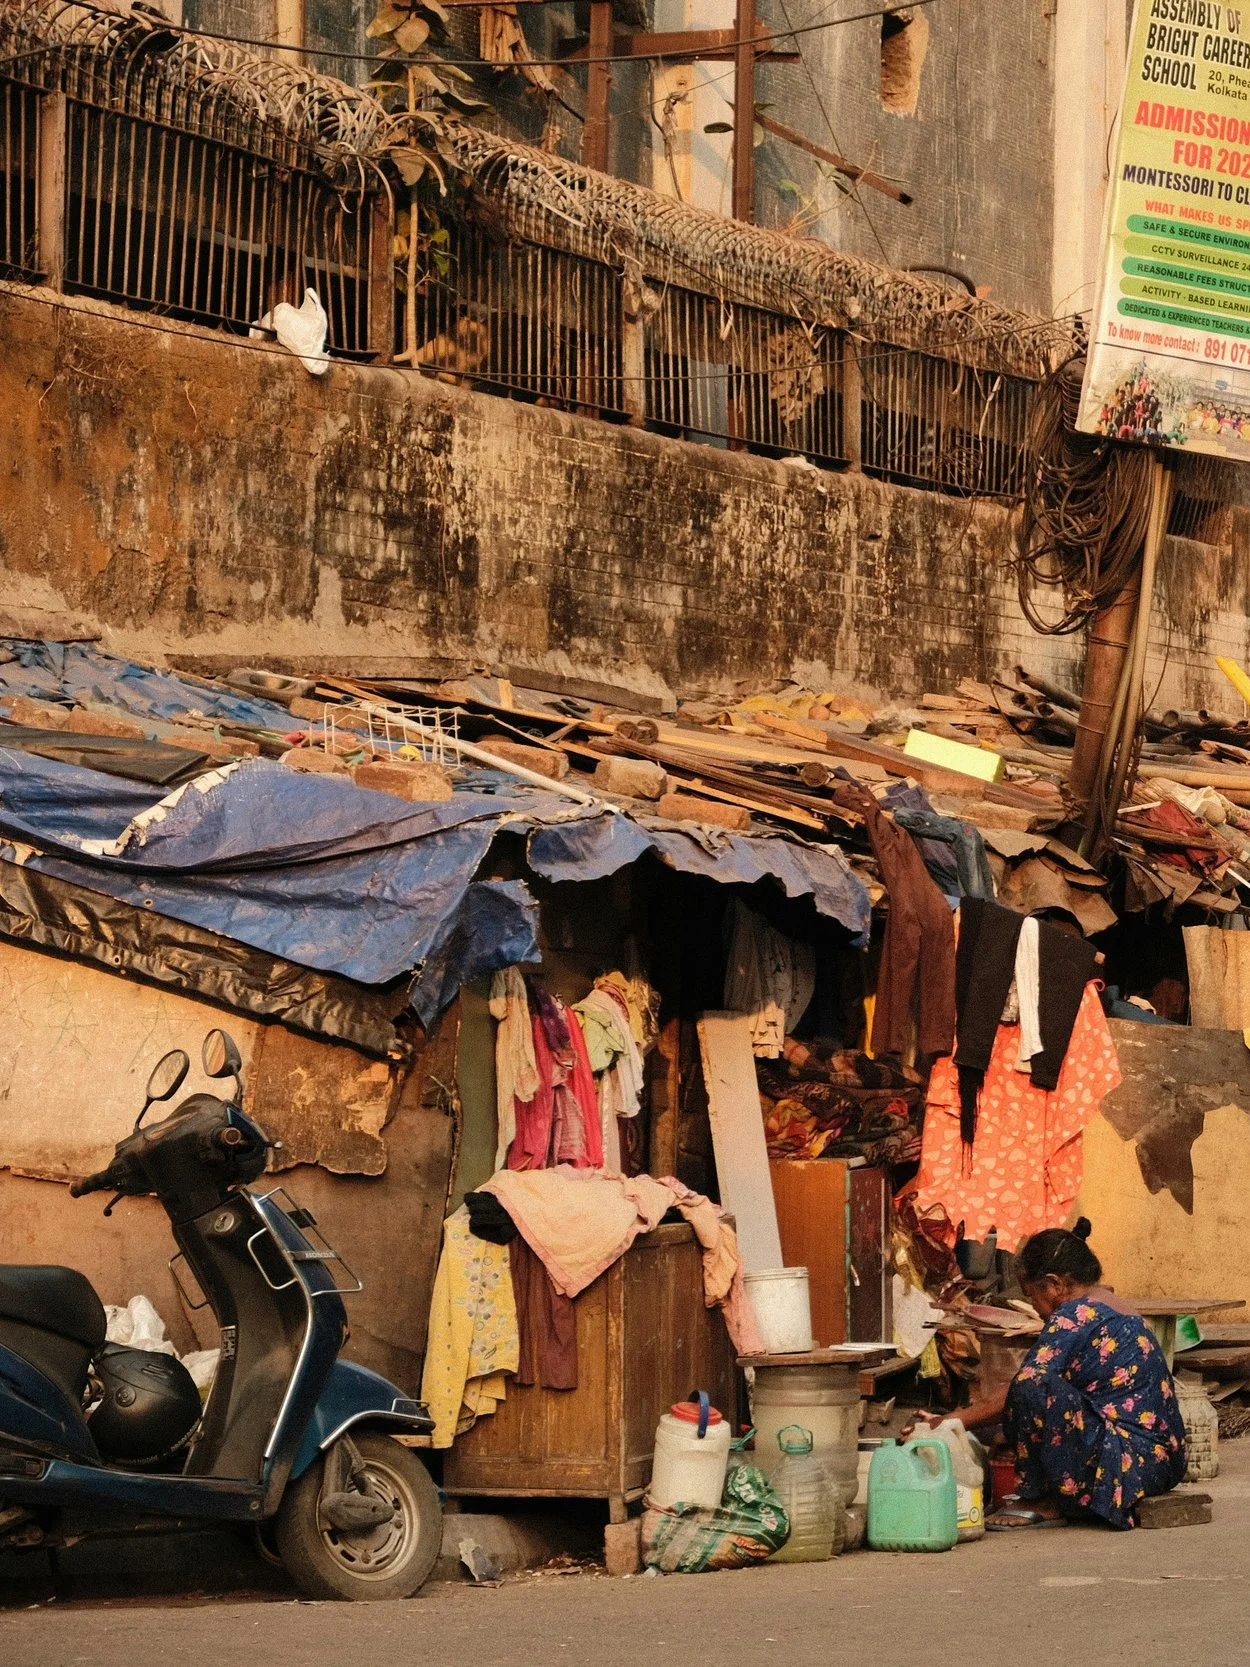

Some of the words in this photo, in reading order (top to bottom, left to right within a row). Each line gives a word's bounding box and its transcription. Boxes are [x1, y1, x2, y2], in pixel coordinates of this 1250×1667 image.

[1150, 0, 1221, 30] ASSEMBLY
[1227, 8, 1241, 34] OF
[1146, 23, 1199, 57] BRIGHT
[1203, 34, 1250, 69] CAREER
[1142, 55, 1196, 90] SCHOOL
[1208, 70, 1225, 84] 20,
[1208, 83, 1247, 101] Kolkata
[1172, 140, 1213, 170] FOR
[1123, 164, 1214, 197] MONTESSORI
[1218, 182, 1232, 201] TO
[1145, 200, 1175, 216] WHAT
[1179, 207, 1214, 224] MAKES
[1218, 214, 1232, 227] US
[1143, 221, 1167, 233] SAFE
[1169, 226, 1175, 234] &
[1179, 227, 1211, 242] SECURE
[1151, 244, 1175, 257] CCTV
[1177, 250, 1239, 270] SURVEILLANCE
[1137, 263, 1194, 282] REASONABLE
[1196, 275, 1217, 287] FEES
[1142, 285, 1181, 300] ACTIVITY
[1188, 294, 1215, 306] BASED
[1124, 303, 1160, 317] DEDICATED
[1168, 311, 1210, 327] EXPERIENCED
[1212, 320, 1244, 334] TEACHERS
[1107, 321, 1117, 337] To
[1119, 324, 1141, 342] know
[1143, 332, 1162, 346] more
[1204, 337, 1226, 359] 891
